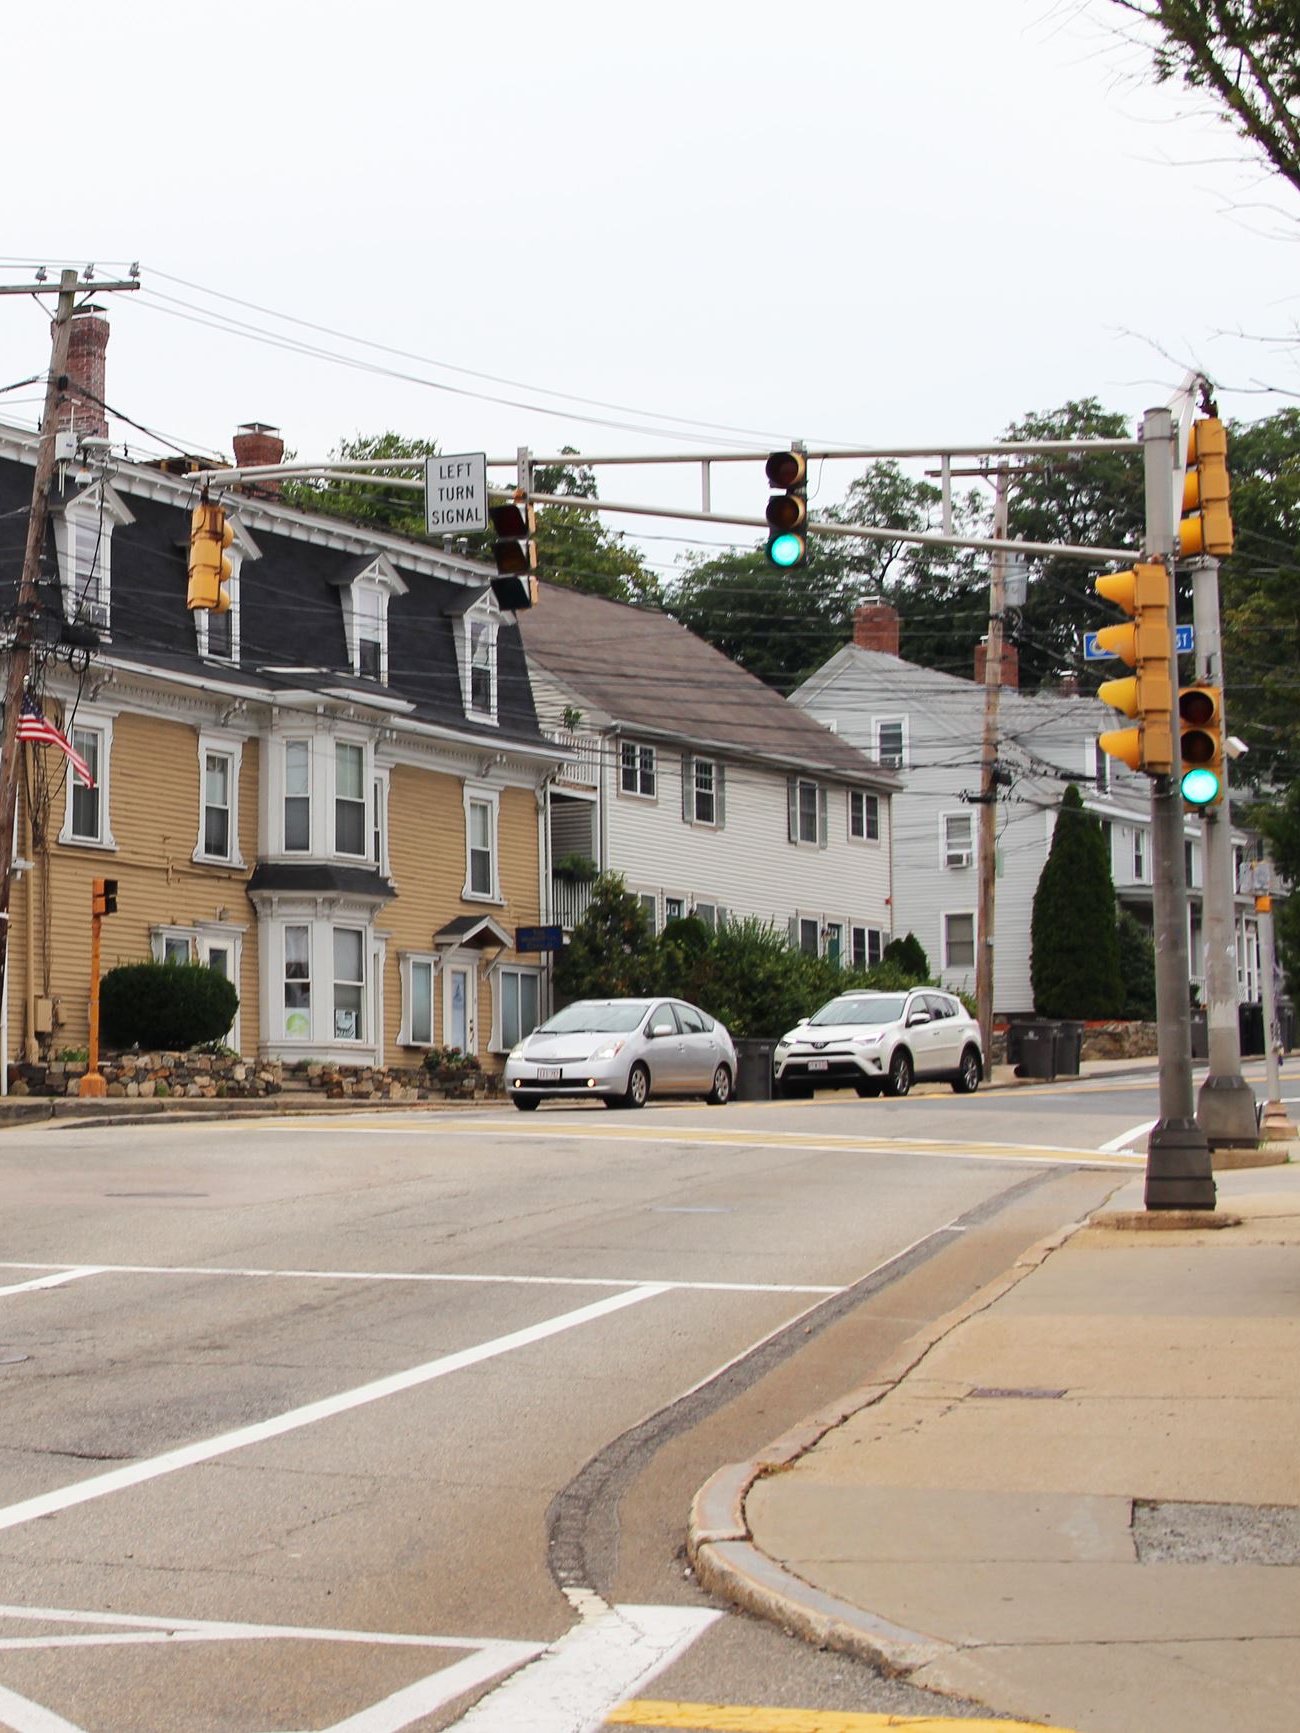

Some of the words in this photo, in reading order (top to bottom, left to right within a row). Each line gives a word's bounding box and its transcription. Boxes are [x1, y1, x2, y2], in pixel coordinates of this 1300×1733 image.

[439, 462, 473, 480] LEFT
[438, 485, 474, 502] TURN
[431, 507, 483, 526] SIGNAL
